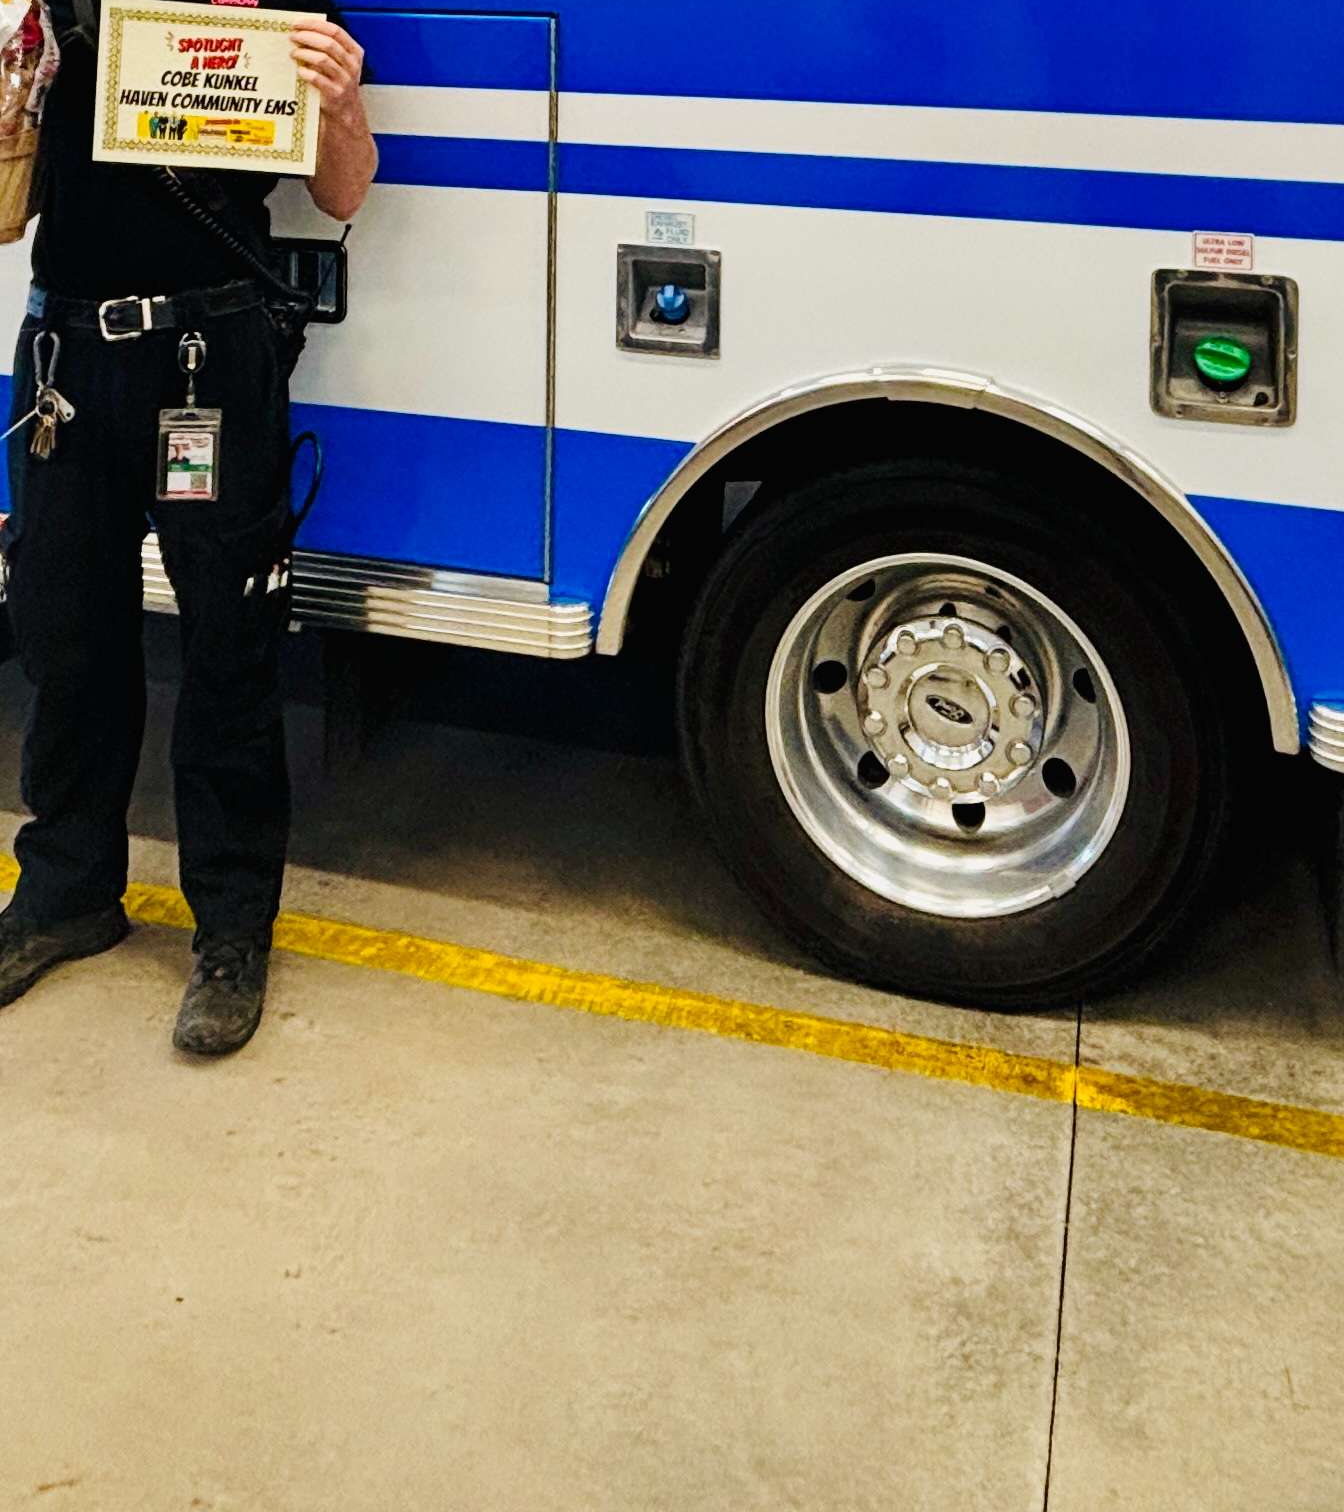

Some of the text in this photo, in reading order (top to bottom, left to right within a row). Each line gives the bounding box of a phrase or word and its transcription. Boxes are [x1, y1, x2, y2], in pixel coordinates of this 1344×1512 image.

[178, 38, 244, 53] SPOTLIGHT
[190, 56, 199, 70] A
[161, 70, 259, 92] COBE KUNKEL
[119, 89, 299, 116] HAVEN COMMUNITY EMS
